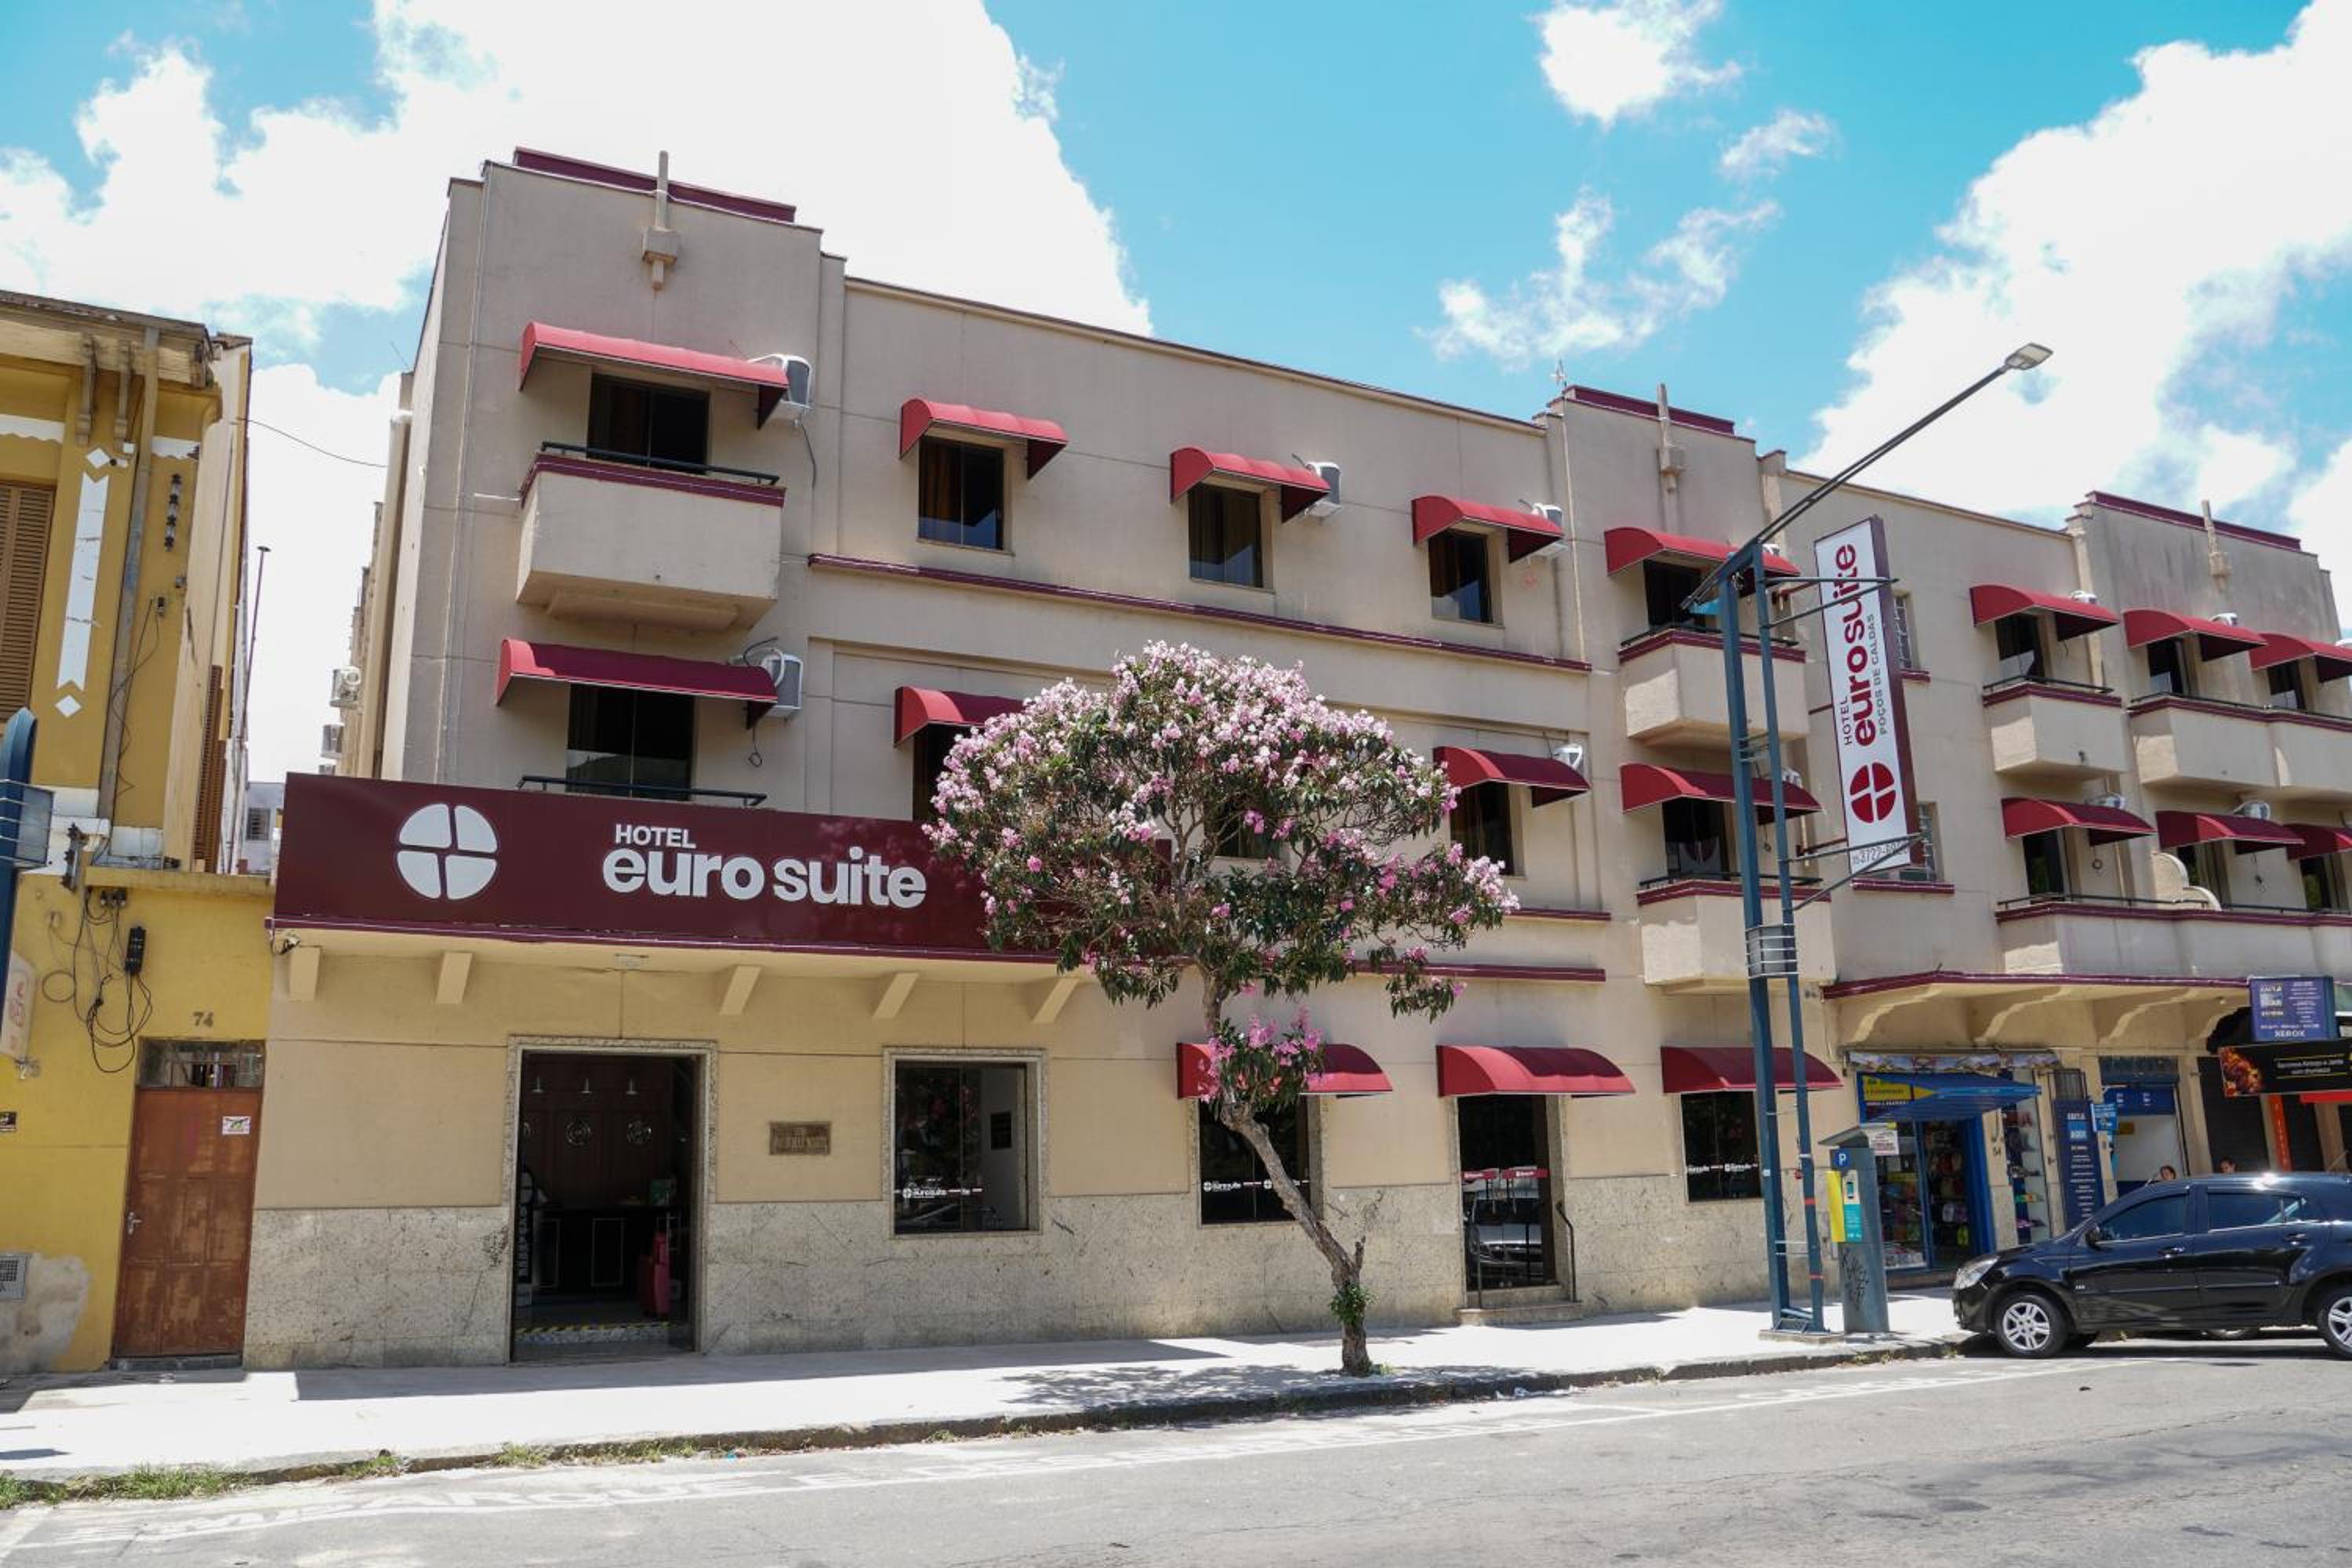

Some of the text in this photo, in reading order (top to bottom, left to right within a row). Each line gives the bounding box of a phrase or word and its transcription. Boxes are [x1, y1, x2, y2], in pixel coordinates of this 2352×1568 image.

[1867, 614, 1887, 735] POÇOS DE CALDAS
[1840, 695, 1853, 746] HOTEL
[615, 824, 697, 849] HOTEL
[193, 1011, 214, 1028] 74
[1838, 1153, 1847, 1166] P
